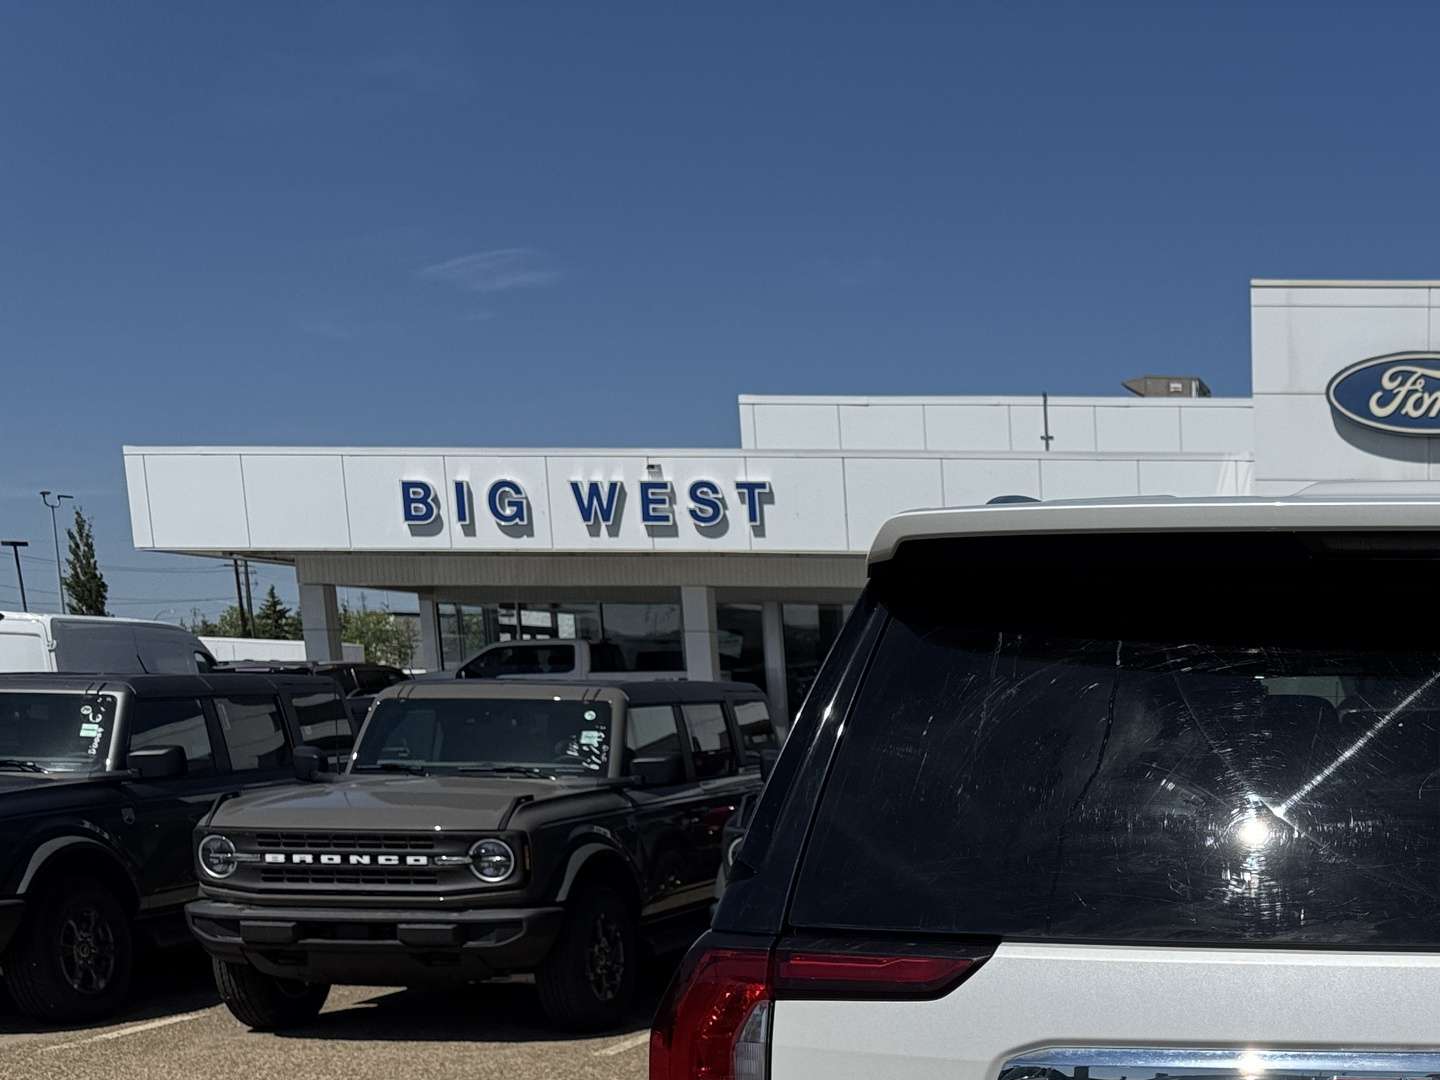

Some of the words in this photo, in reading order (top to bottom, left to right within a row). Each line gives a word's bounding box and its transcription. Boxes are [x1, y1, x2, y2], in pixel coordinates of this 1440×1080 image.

[401, 480, 528, 525] BIG
[570, 480, 770, 526] WEST
[264, 853, 429, 866] BRONCO
